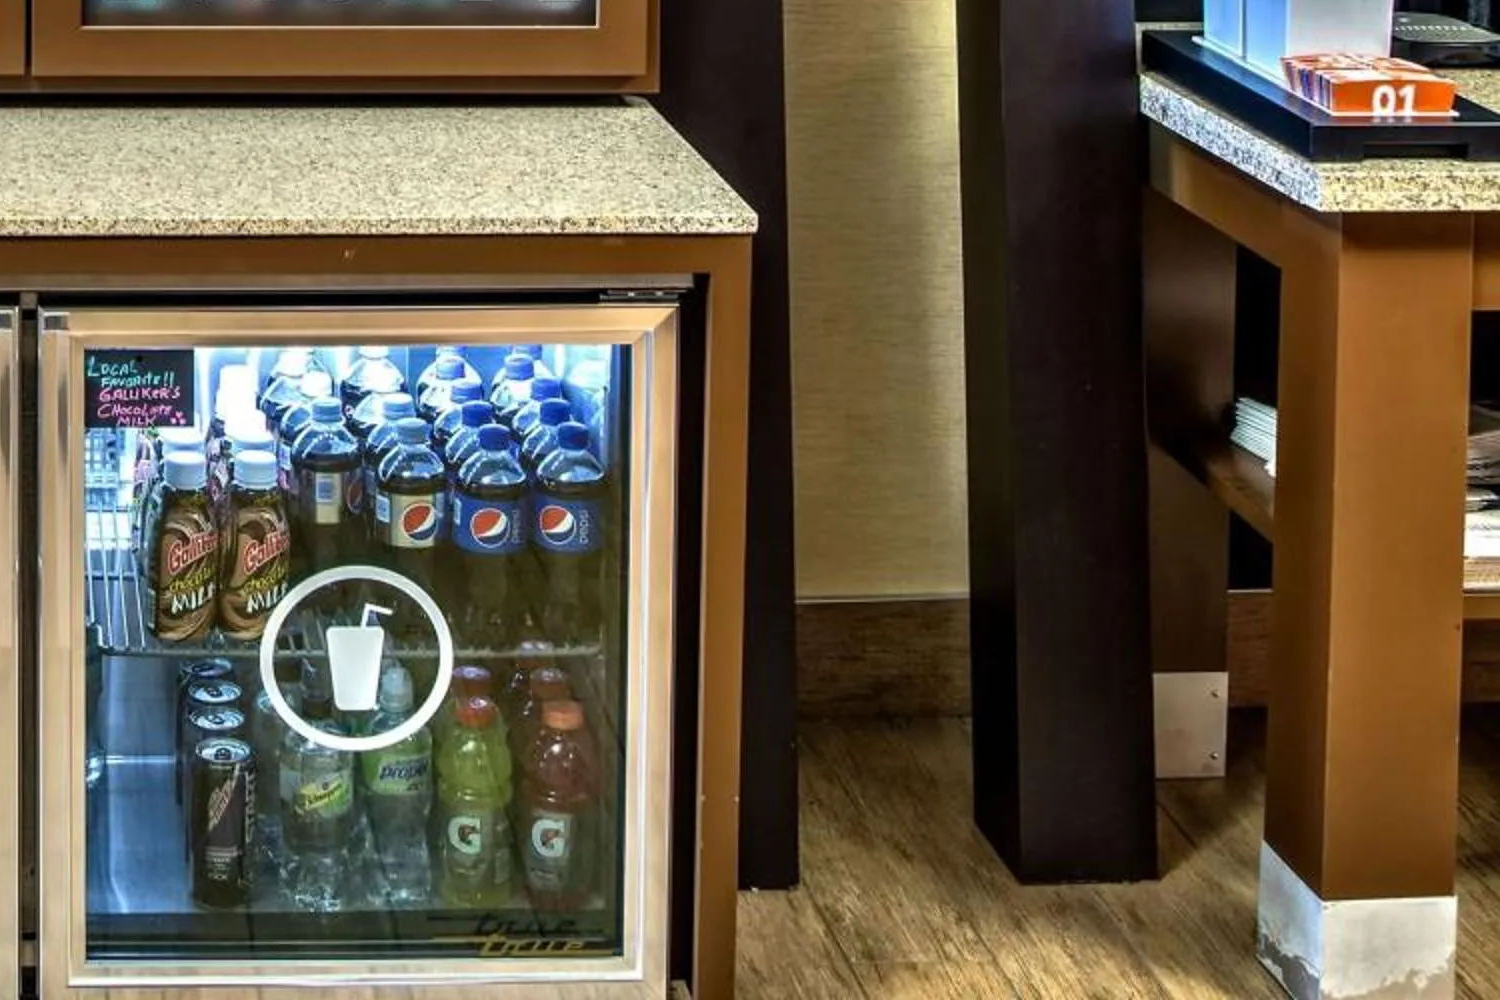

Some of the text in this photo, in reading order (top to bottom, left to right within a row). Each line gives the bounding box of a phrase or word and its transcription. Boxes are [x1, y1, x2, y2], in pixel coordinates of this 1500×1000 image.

[1371, 84, 1418, 115] 01
[448, 817, 481, 855] G
[531, 818, 566, 858] G
